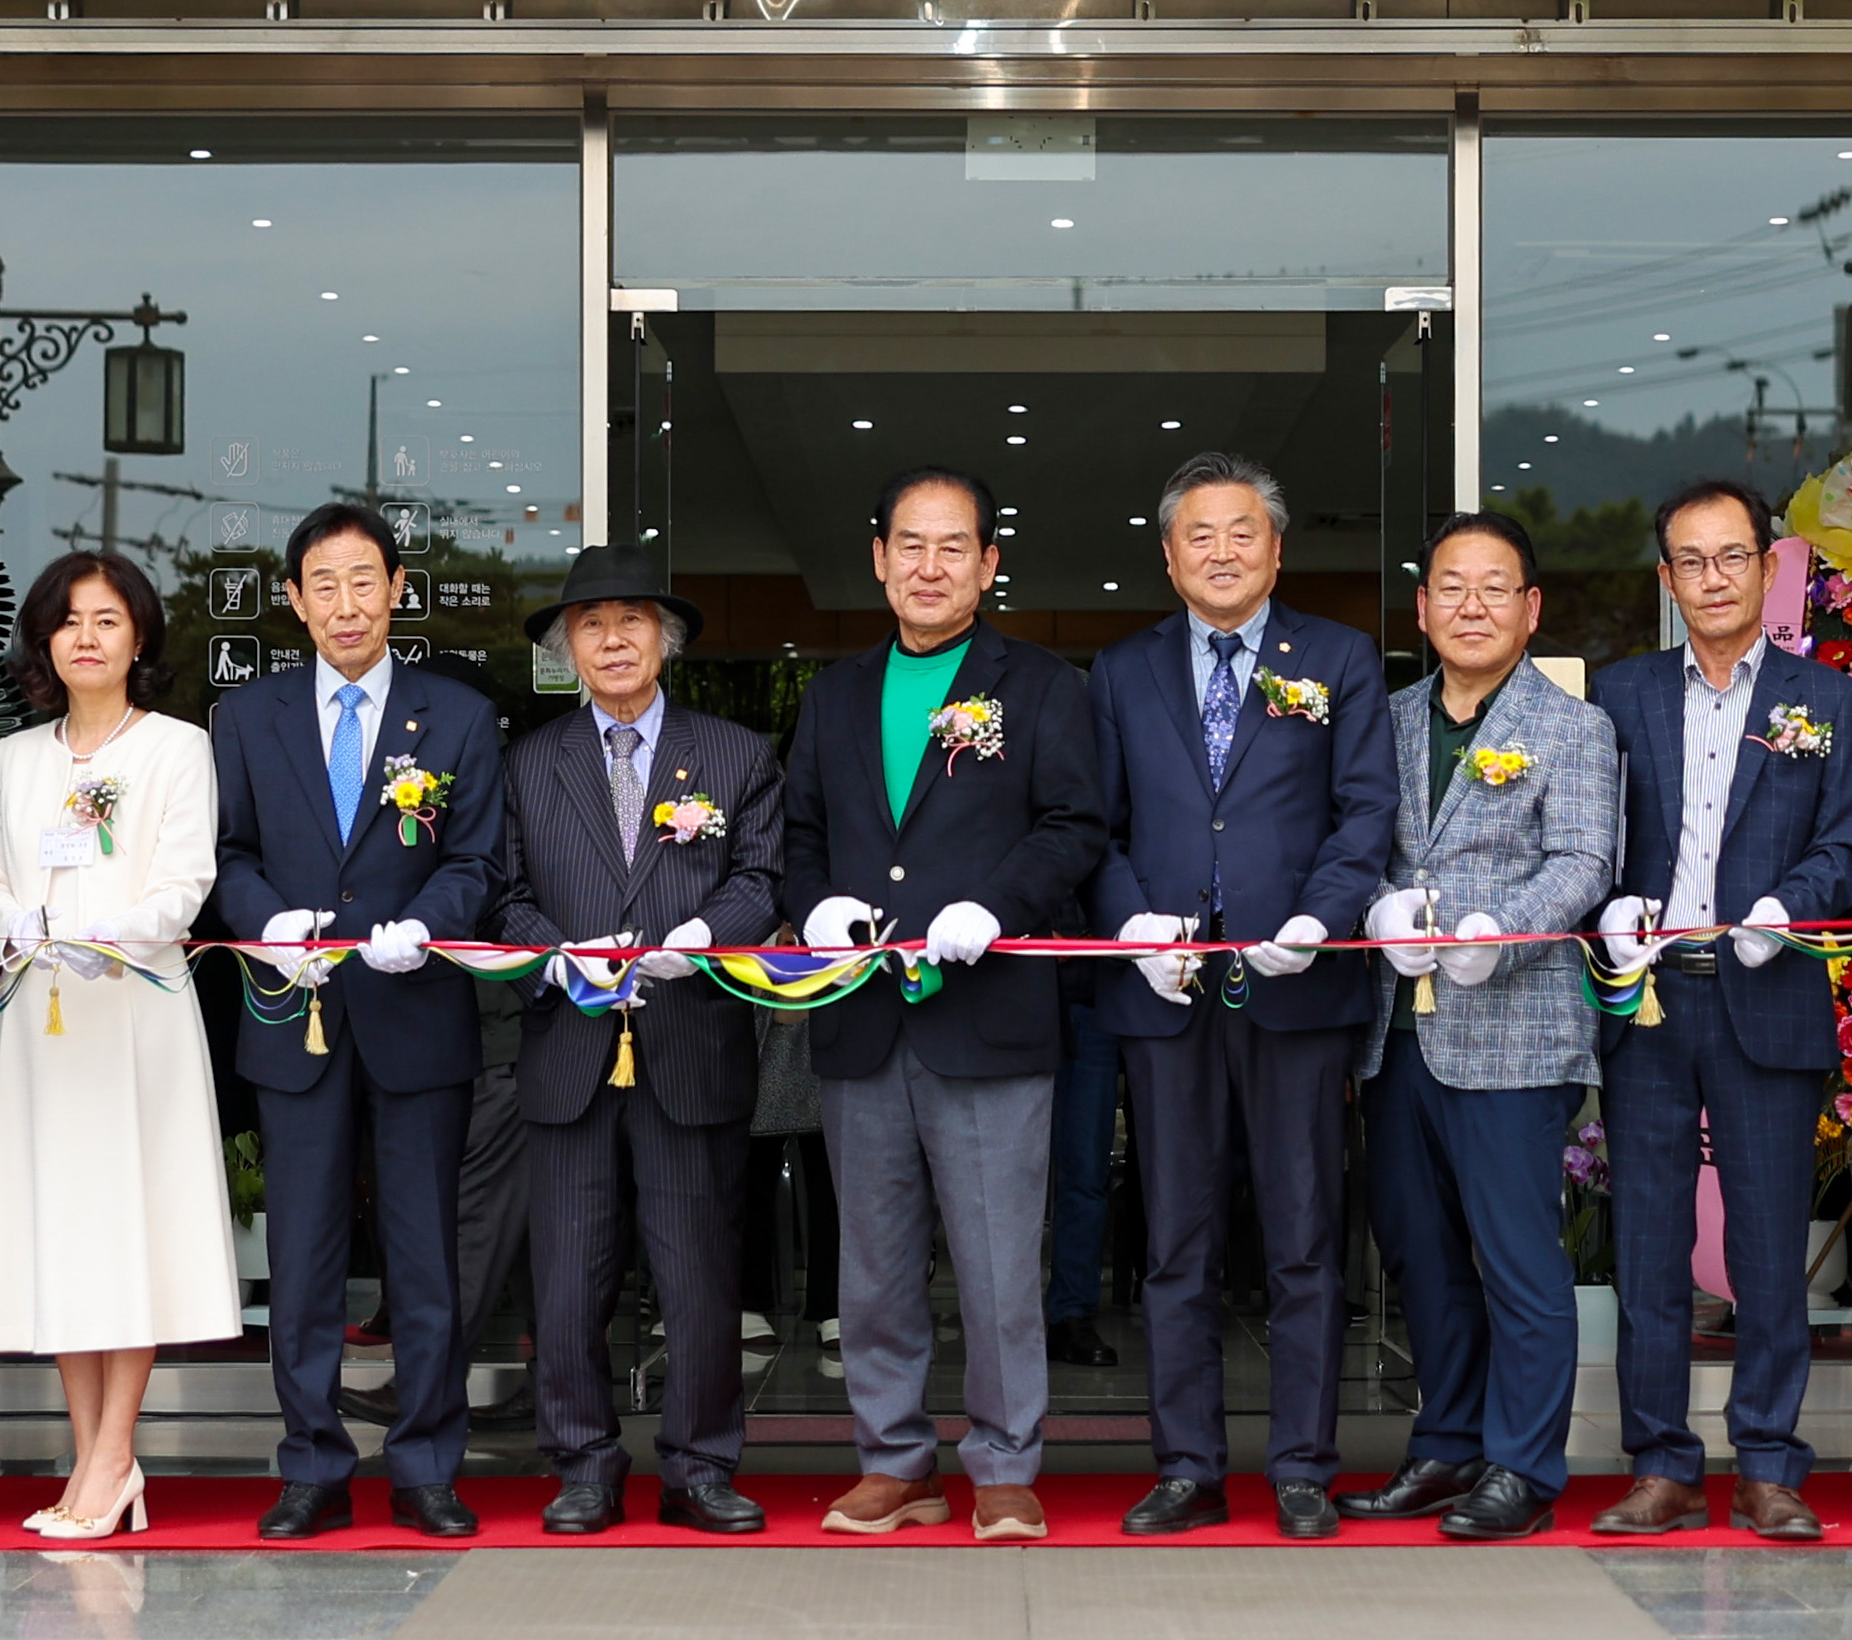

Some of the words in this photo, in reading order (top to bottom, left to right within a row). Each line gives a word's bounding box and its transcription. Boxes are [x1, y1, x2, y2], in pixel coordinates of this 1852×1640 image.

[471, 583, 491, 594] 때는
[439, 595, 459, 607] 작은
[461, 596, 491, 607] 소리로
[270, 649, 300, 661] 안내견
